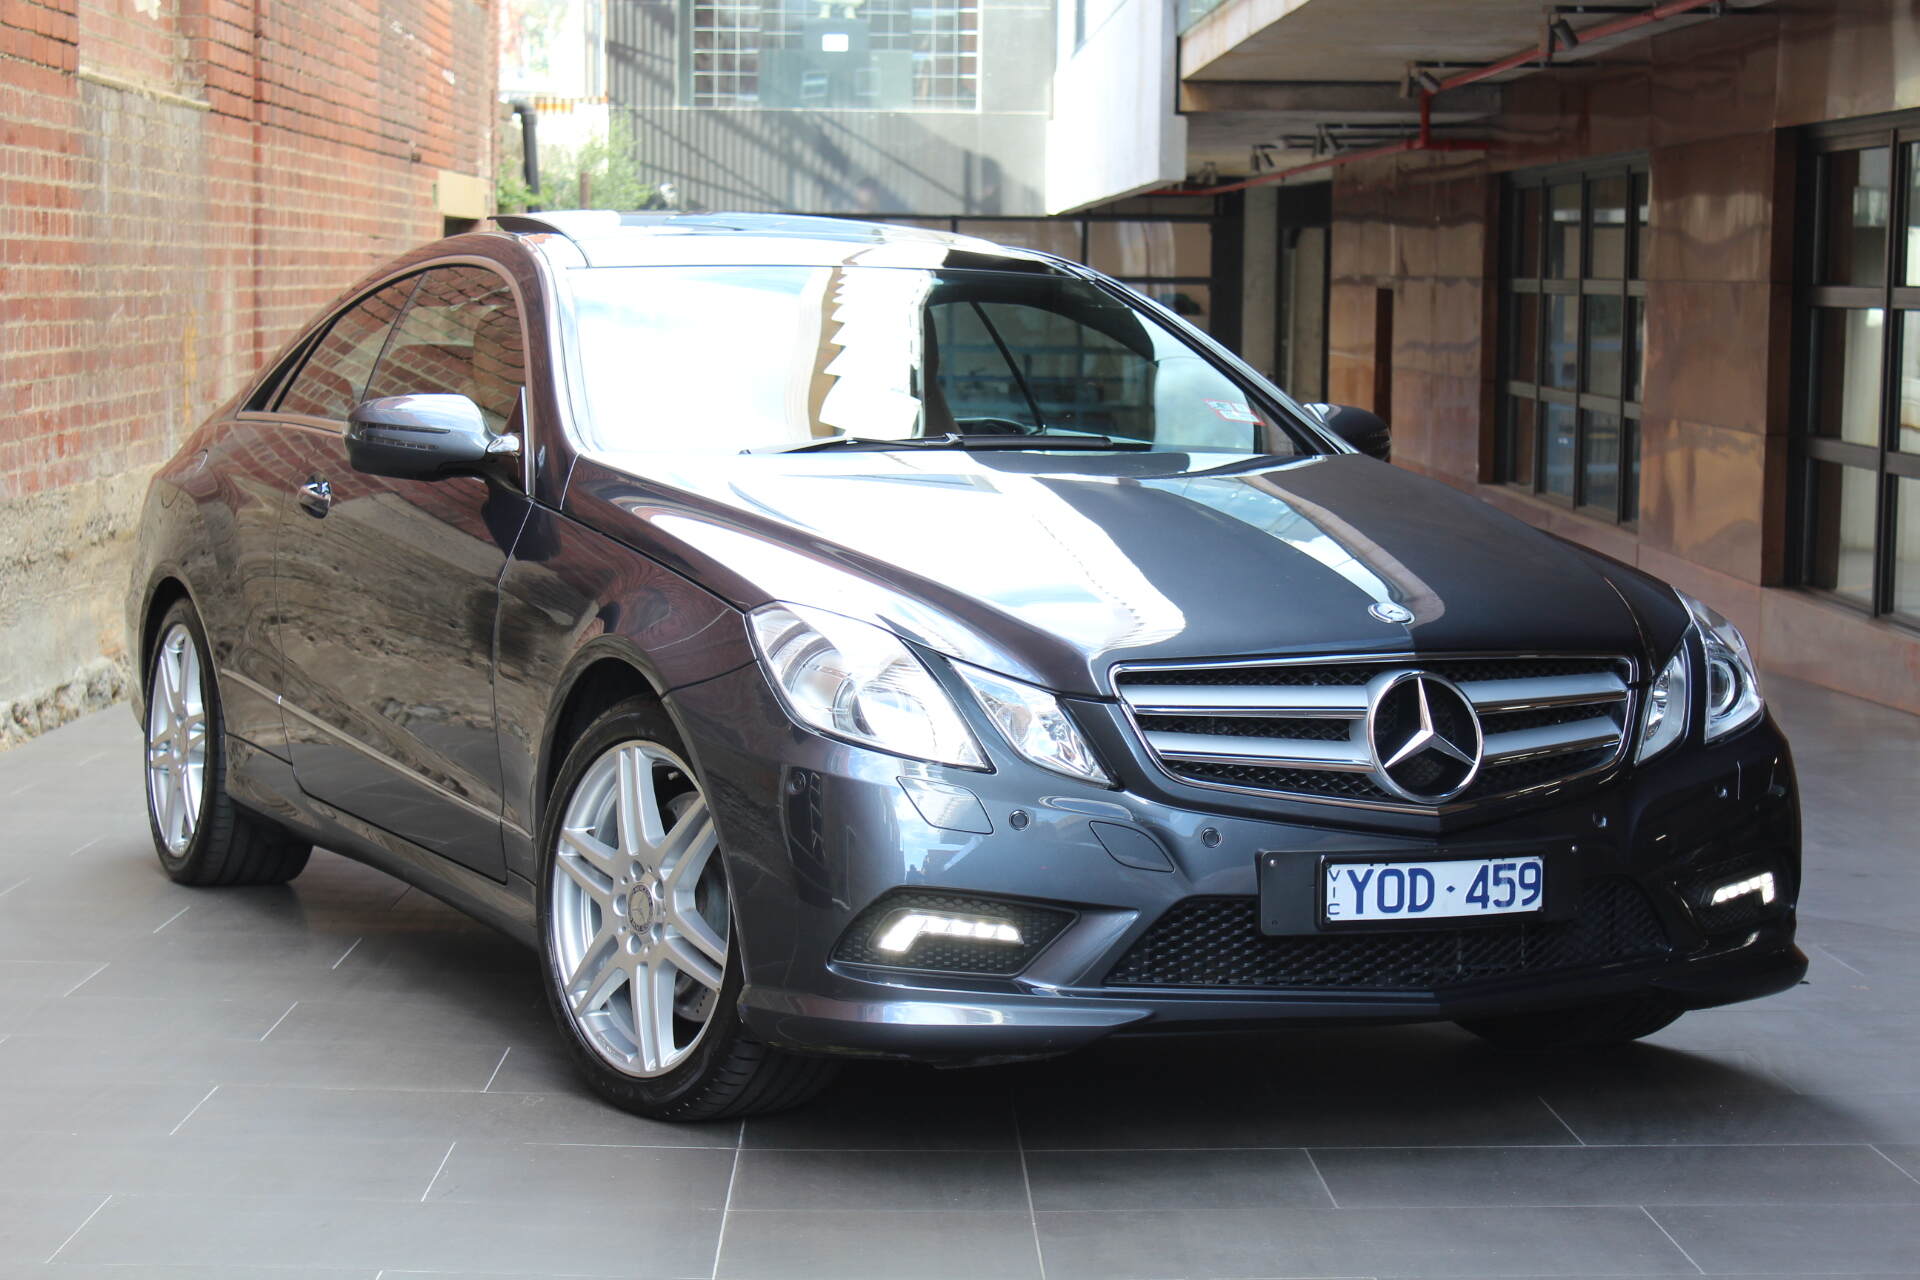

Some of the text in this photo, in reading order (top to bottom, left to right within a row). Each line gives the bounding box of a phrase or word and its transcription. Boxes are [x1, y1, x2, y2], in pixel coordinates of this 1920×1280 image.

[1327, 869, 1341, 916] VIC
[1347, 861, 1542, 914] YOD 459
